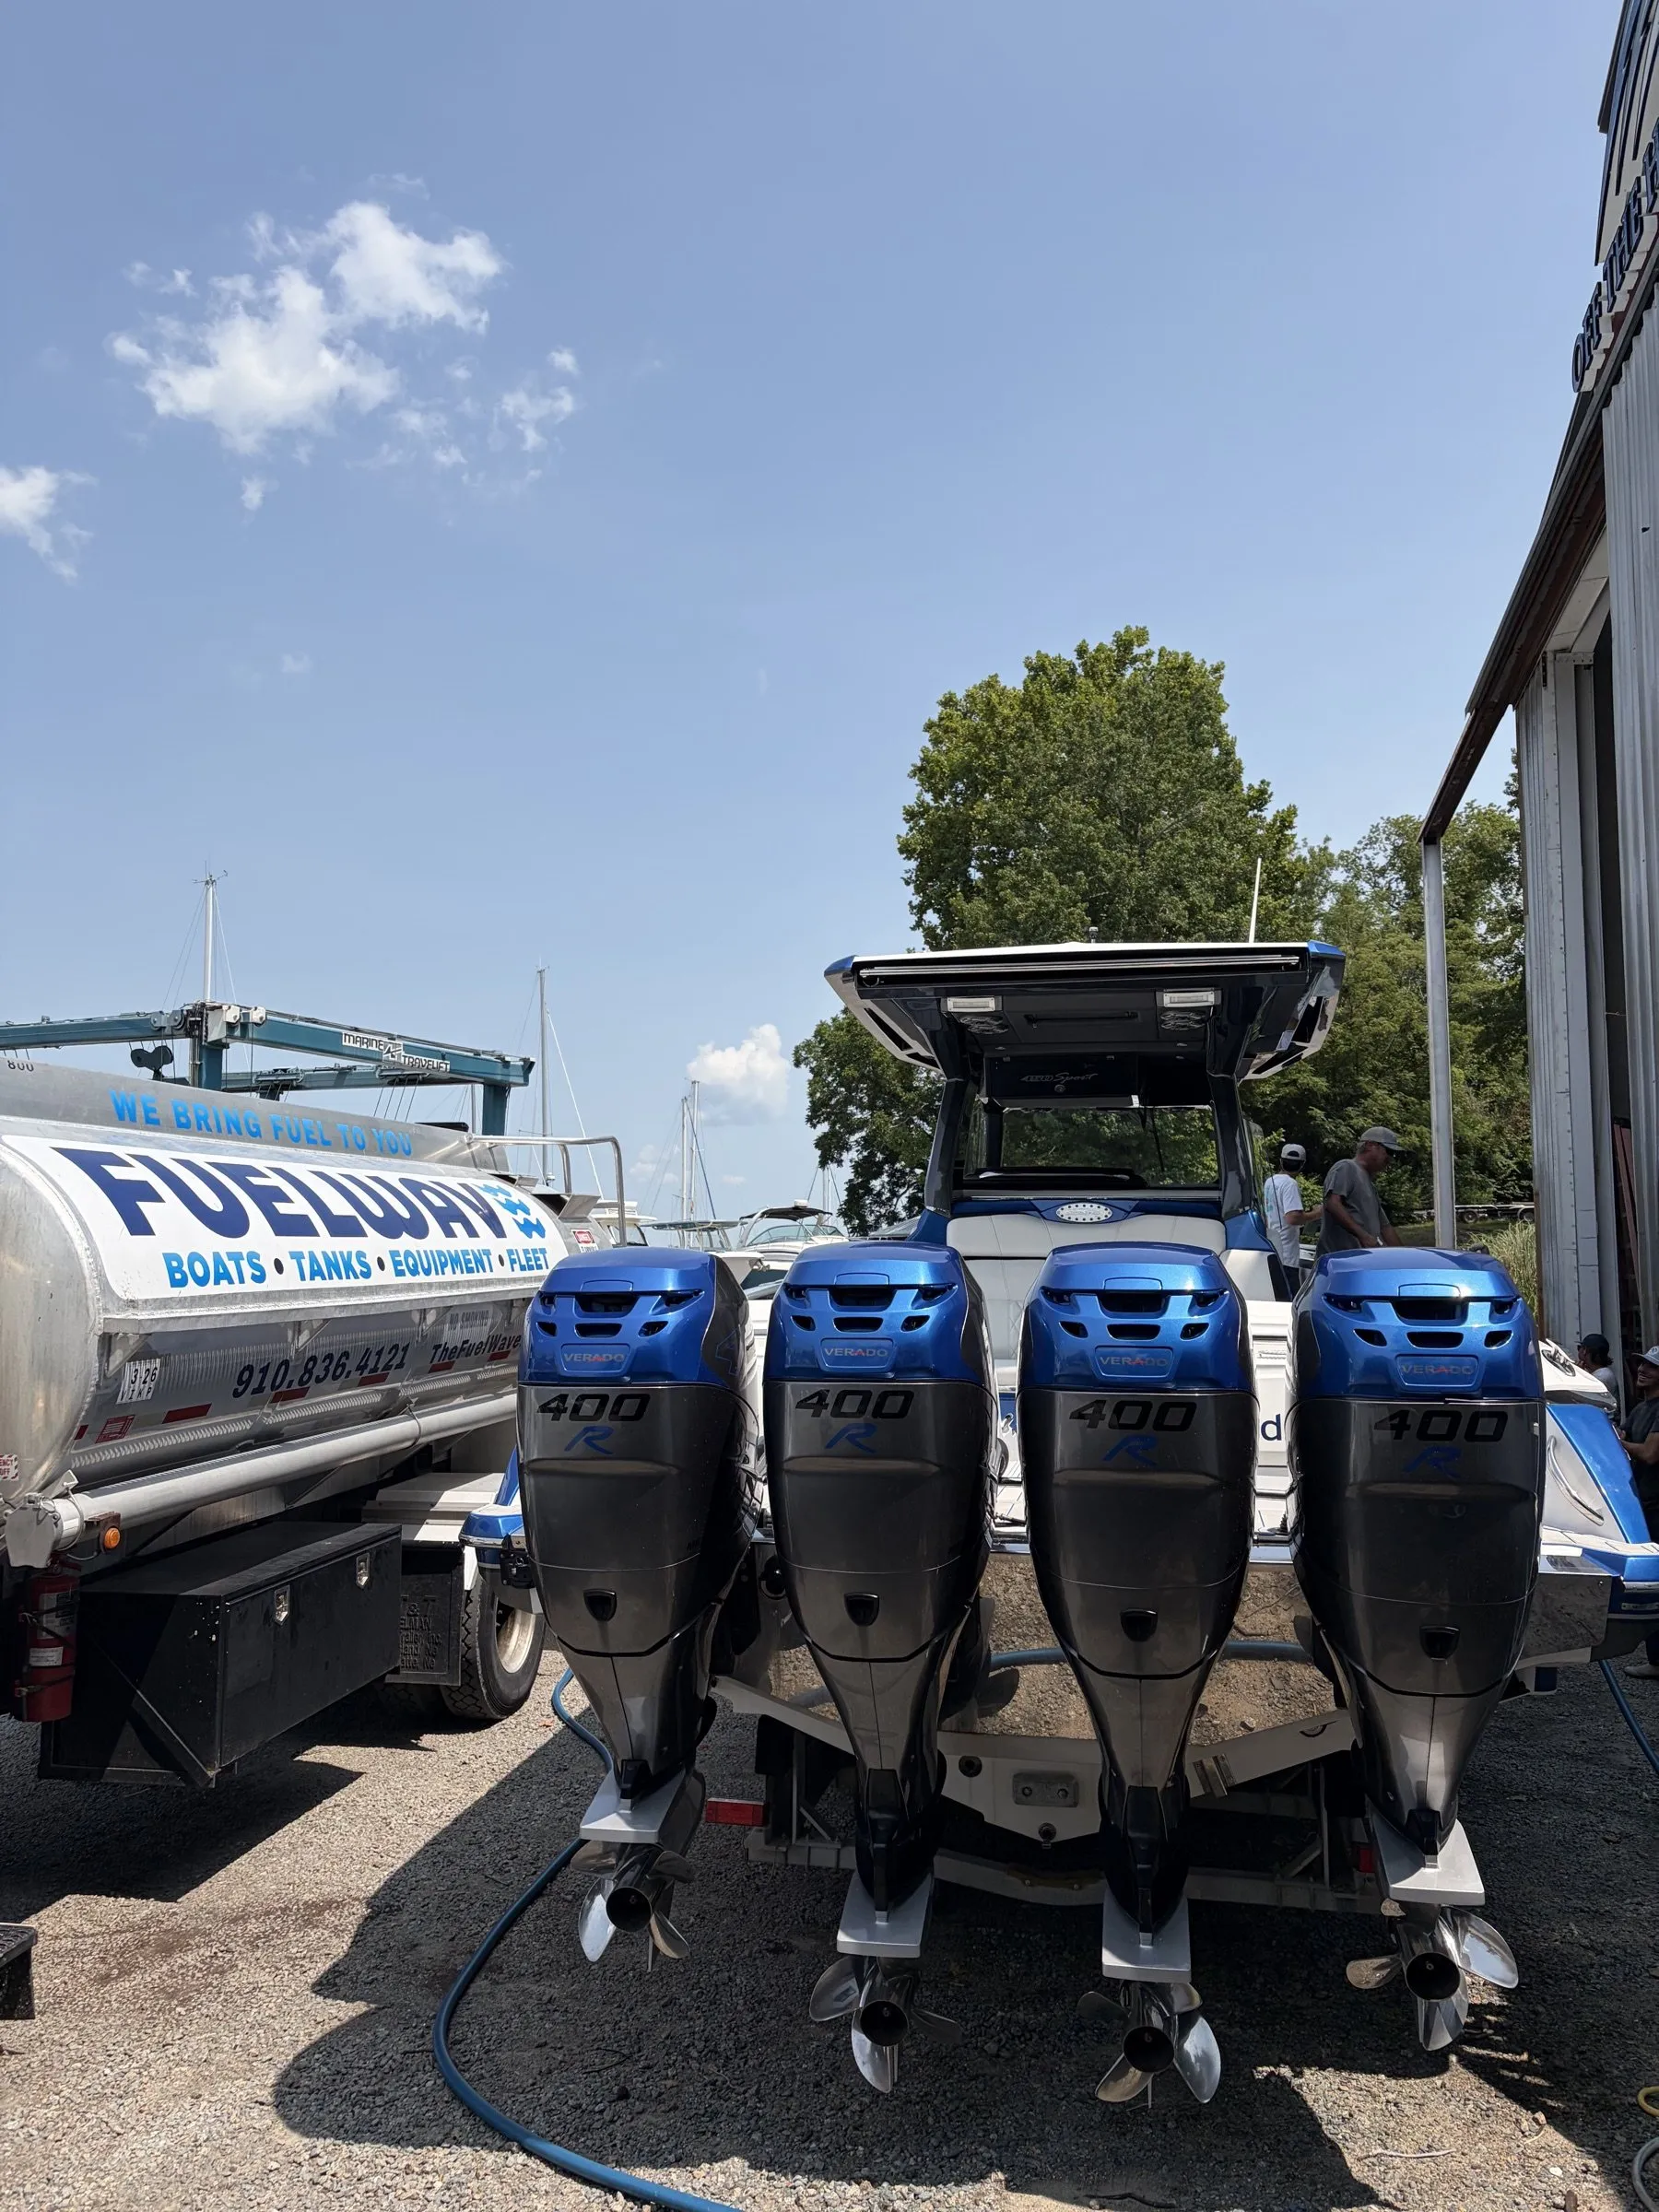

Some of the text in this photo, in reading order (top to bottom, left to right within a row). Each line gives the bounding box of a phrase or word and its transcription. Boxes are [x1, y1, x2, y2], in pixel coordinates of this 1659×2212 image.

[344, 1033, 384, 1051] MARINE
[402, 1055, 450, 1072] TRAVELIFT
[108, 1089, 412, 1157] WE BRING FUEL TO YOU
[161, 1247, 550, 1288] BOATS TANKS EQUIPMENT FLEET
[563, 1352, 625, 1362] VERADO
[823, 1347, 888, 1357] VERADO
[1100, 1356, 1170, 1367] VERADO
[231, 1341, 411, 1398] 910.836.4121
[1401, 1364, 1474, 1375] VERADO
[537, 1393, 651, 1422] 400
[795, 1388, 915, 1419] 400
[1069, 1399, 1197, 1431] 400
[564, 1425, 615, 1455] R
[825, 1422, 877, 1454] R
[1374, 1409, 1509, 1442] 400
[1101, 1434, 1158, 1465] R
[1402, 1445, 1462, 1477] R
[399, 1616, 432, 1630] ELMAN
